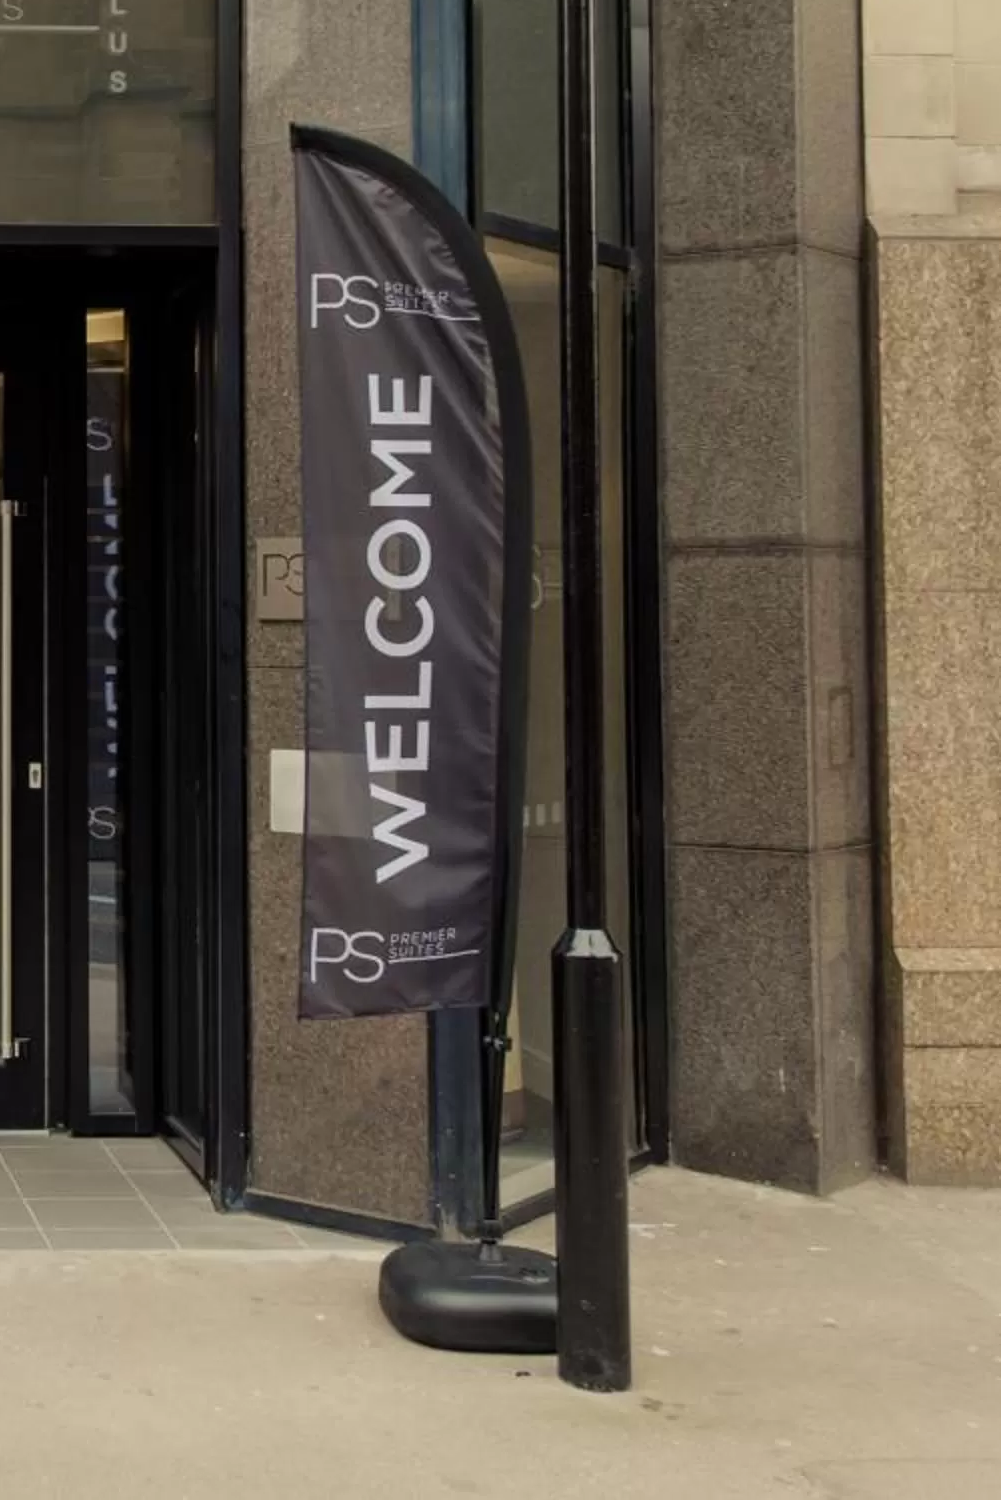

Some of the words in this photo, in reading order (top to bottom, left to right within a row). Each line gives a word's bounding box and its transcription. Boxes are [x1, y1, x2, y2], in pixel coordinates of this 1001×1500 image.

[310, 273, 380, 329] PS
[364, 373, 434, 884] WELCOME
[310, 927, 385, 985] PS
[387, 941, 445, 959] SUITES
[390, 927, 456, 946] PREMIER
